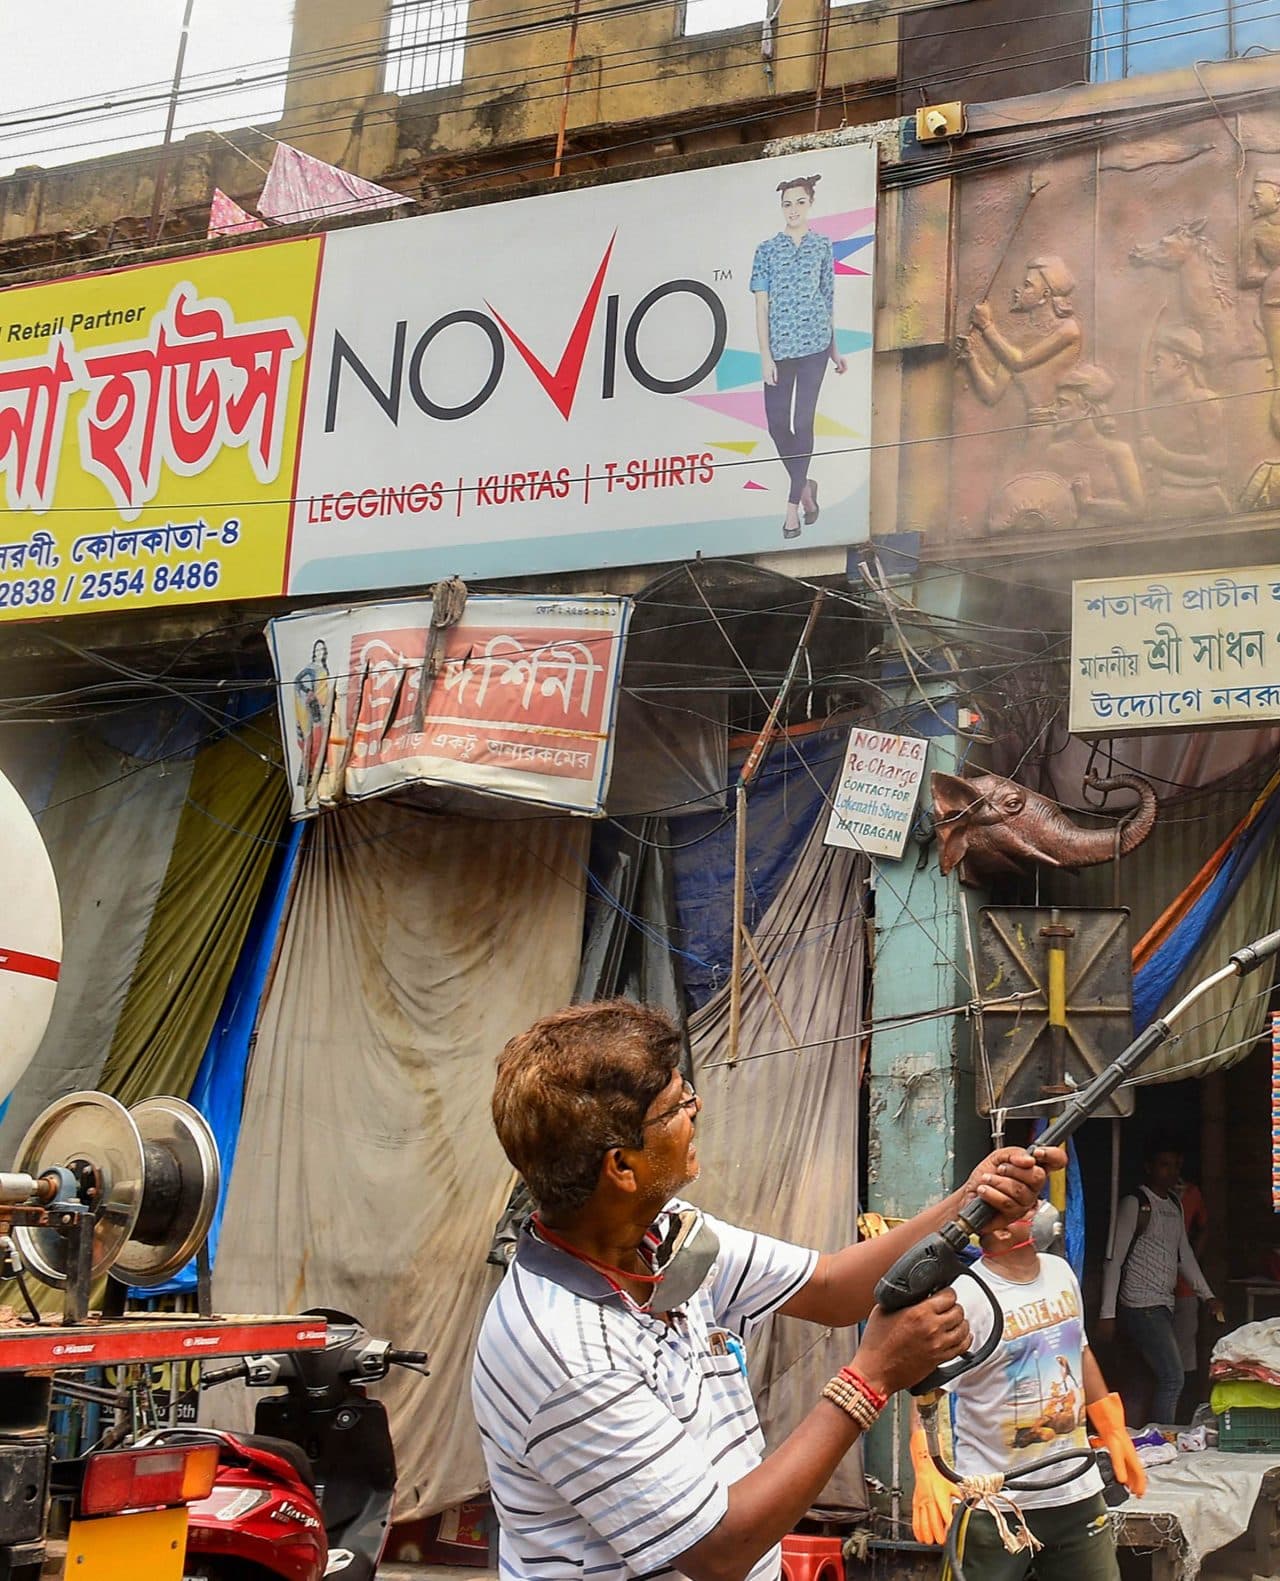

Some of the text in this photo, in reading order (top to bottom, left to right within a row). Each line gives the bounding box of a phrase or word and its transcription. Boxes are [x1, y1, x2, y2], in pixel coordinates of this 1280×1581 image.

[7, 306, 146, 343] Retail Partner
[325, 225, 727, 434] NOVIO
[85, 294, 294, 506] হাউস
[308, 480, 443, 524] LEGGINGS
[478, 467, 570, 508] KURTAS
[605, 452, 715, 494] T-SHIRTS
[0, 520, 239, 570] রণী, কোলকাতা-৪
[80, 569, 144, 601] 2554
[153, 561, 219, 593] 8486
[1084, 584, 1173, 619] শতাব্দী
[1182, 578, 1259, 611] প্রাচীন
[1079, 646, 1140, 680] মাননীয়
[1144, 622, 1182, 676] শ্রী
[1190, 626, 1265, 673] সাধন
[1091, 688, 1201, 719] উদ্যোগে
[431, 734, 480, 759] একটু
[485, 738, 592, 769] অন্যরকমের
[854, 731, 896, 754] NOW
[844, 779, 910, 801] CONTACT FOR
[836, 819, 902, 842] HATIBAGAN
